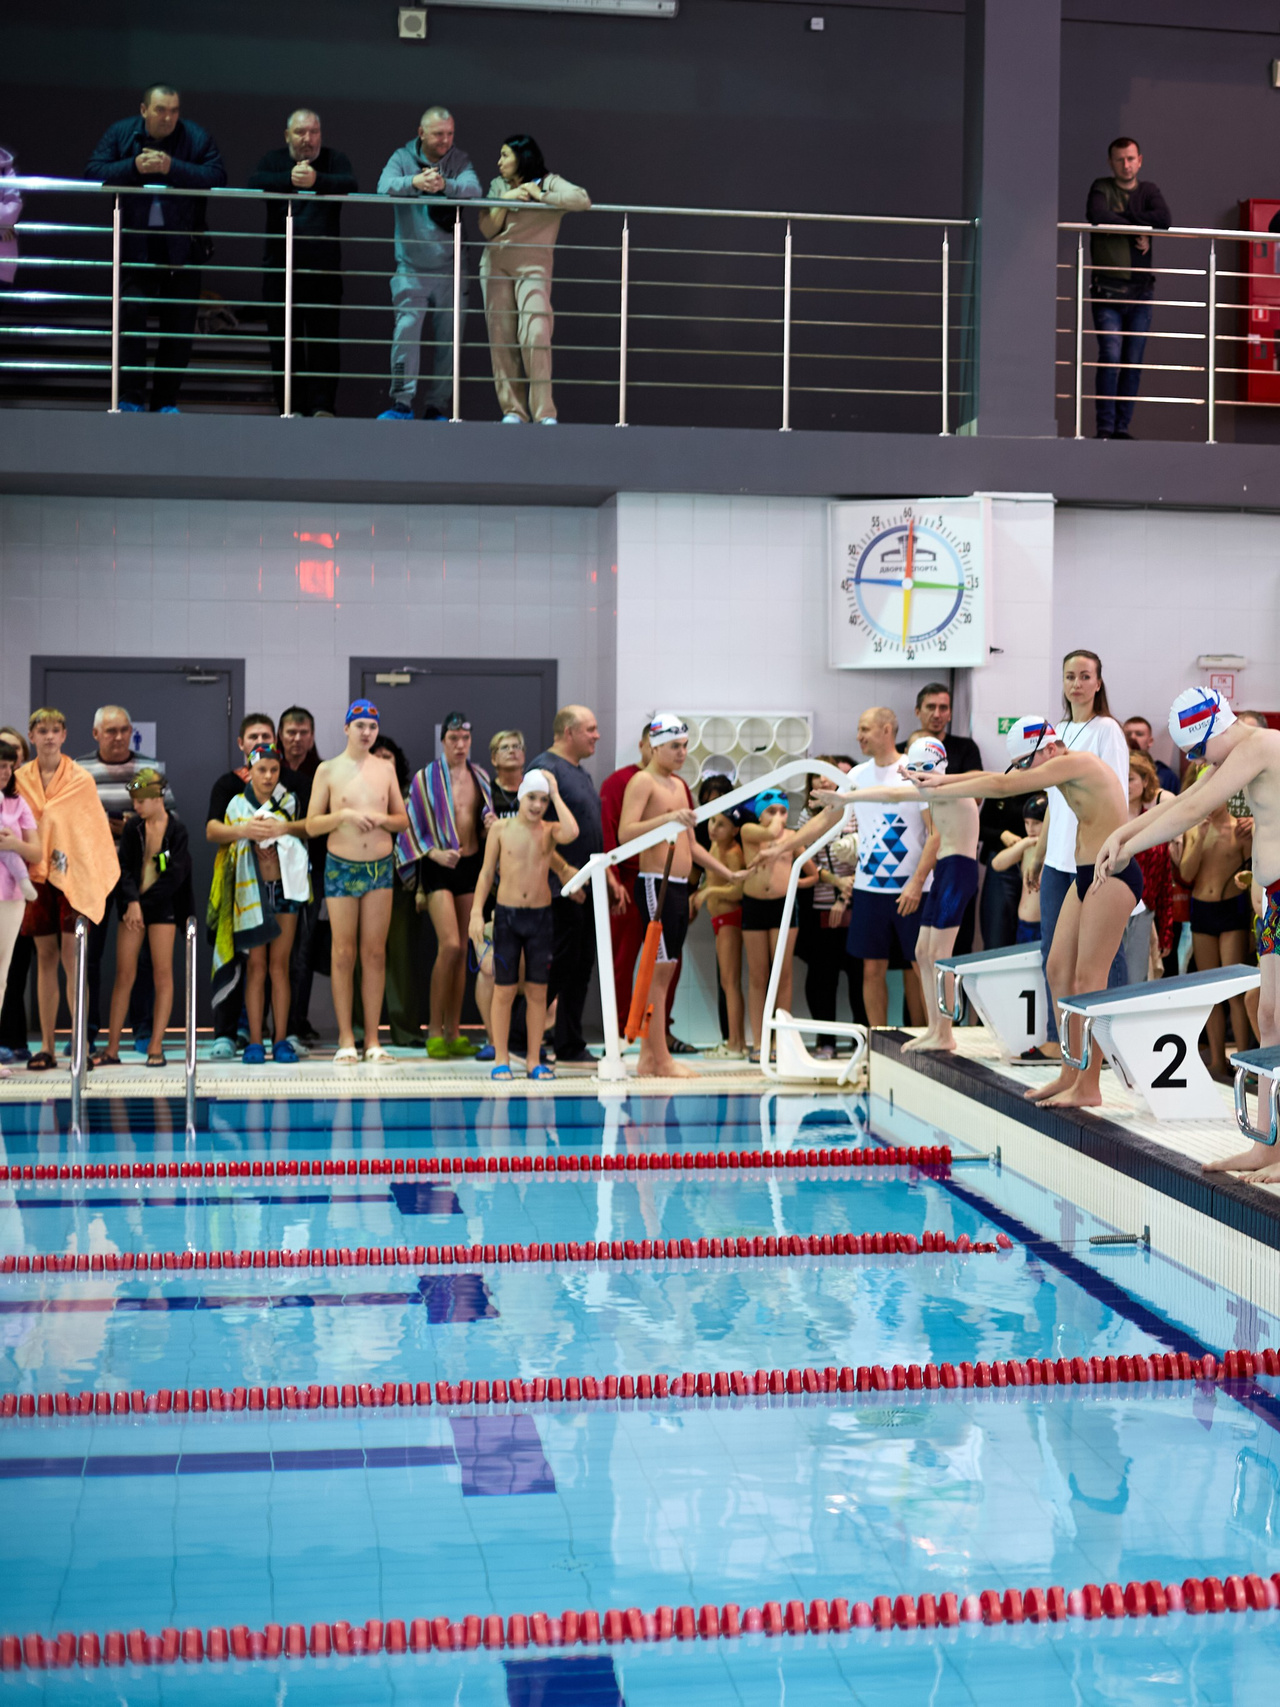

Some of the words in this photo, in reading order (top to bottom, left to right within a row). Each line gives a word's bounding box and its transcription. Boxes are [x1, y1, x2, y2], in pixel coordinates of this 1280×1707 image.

[903, 507, 912, 518] 60
[872, 515, 880, 527] 55
[938, 515, 943, 527] 5
[848, 544, 857, 555] 50
[963, 541, 971, 552] 10
[841, 578, 850, 590] 45
[971, 575, 979, 588] 15
[849, 614, 857, 626] 40
[963, 613, 972, 624] 20
[874, 641, 882, 653] 35
[938, 640, 947, 651] 25
[906, 649, 915, 661] 30
[1018, 990, 1035, 1035] 1
[1151, 1033, 1187, 1088] 2
